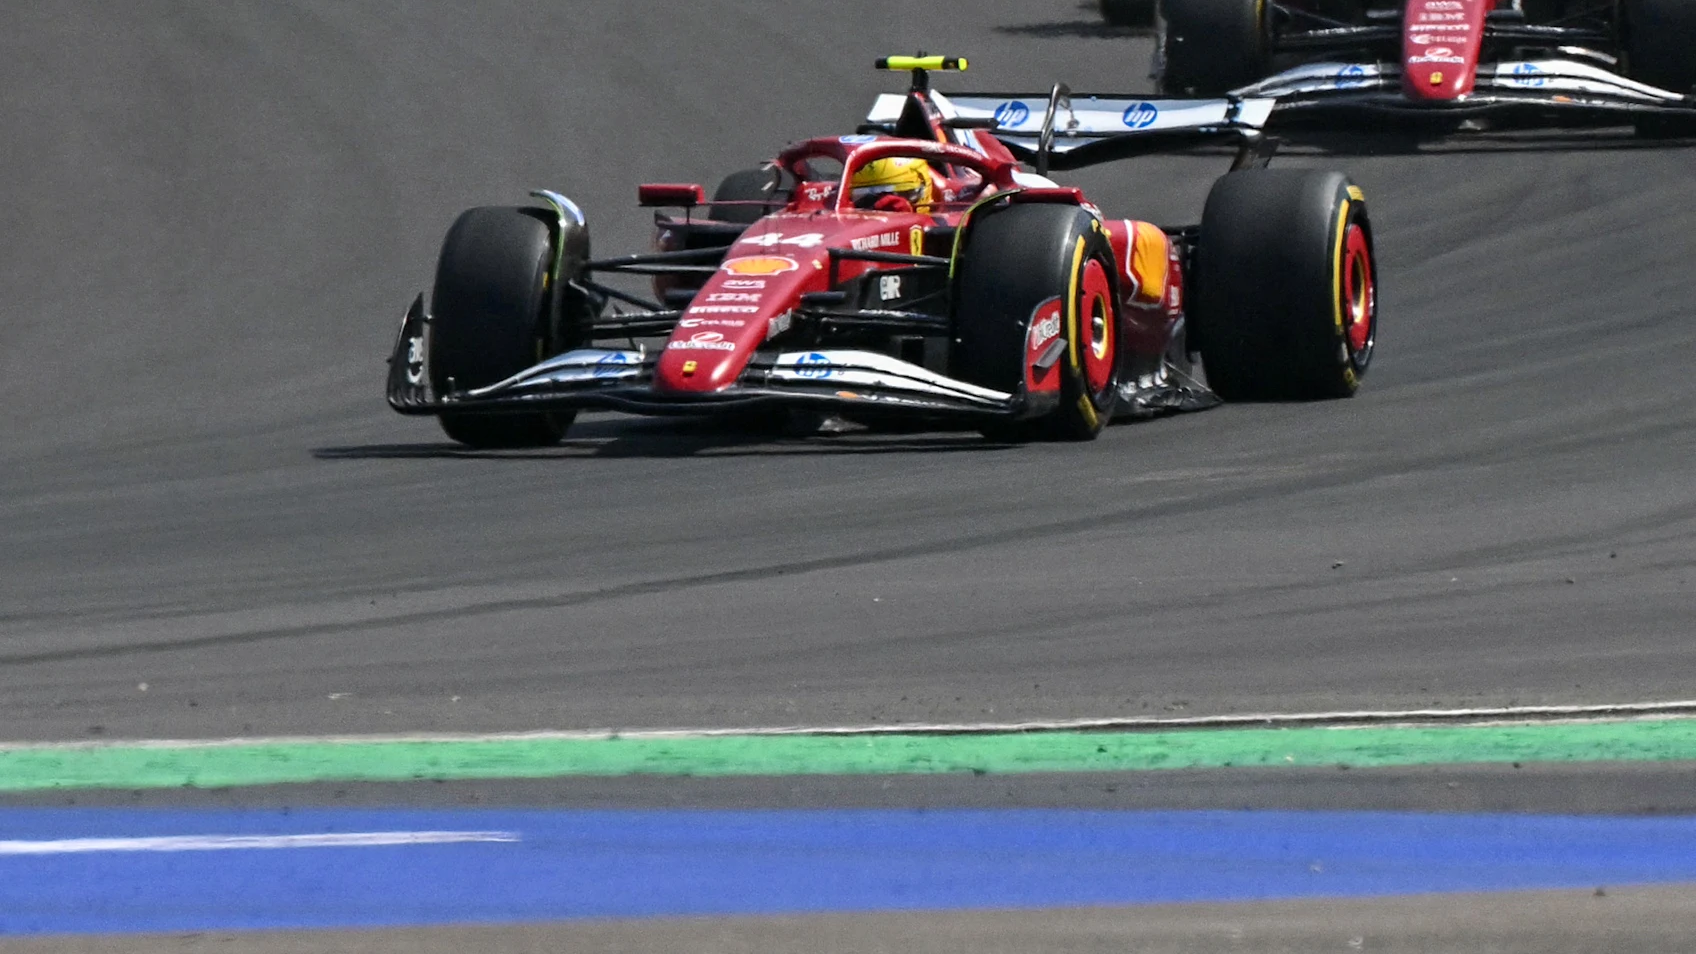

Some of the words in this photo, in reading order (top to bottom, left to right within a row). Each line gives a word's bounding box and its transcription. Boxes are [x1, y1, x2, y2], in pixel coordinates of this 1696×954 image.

[995, 100, 1029, 129] hp
[1123, 102, 1157, 129] hp
[740, 233, 824, 248] 44
[880, 231, 900, 247] MILLE
[705, 293, 762, 302] IBM
[794, 353, 832, 379] hp
